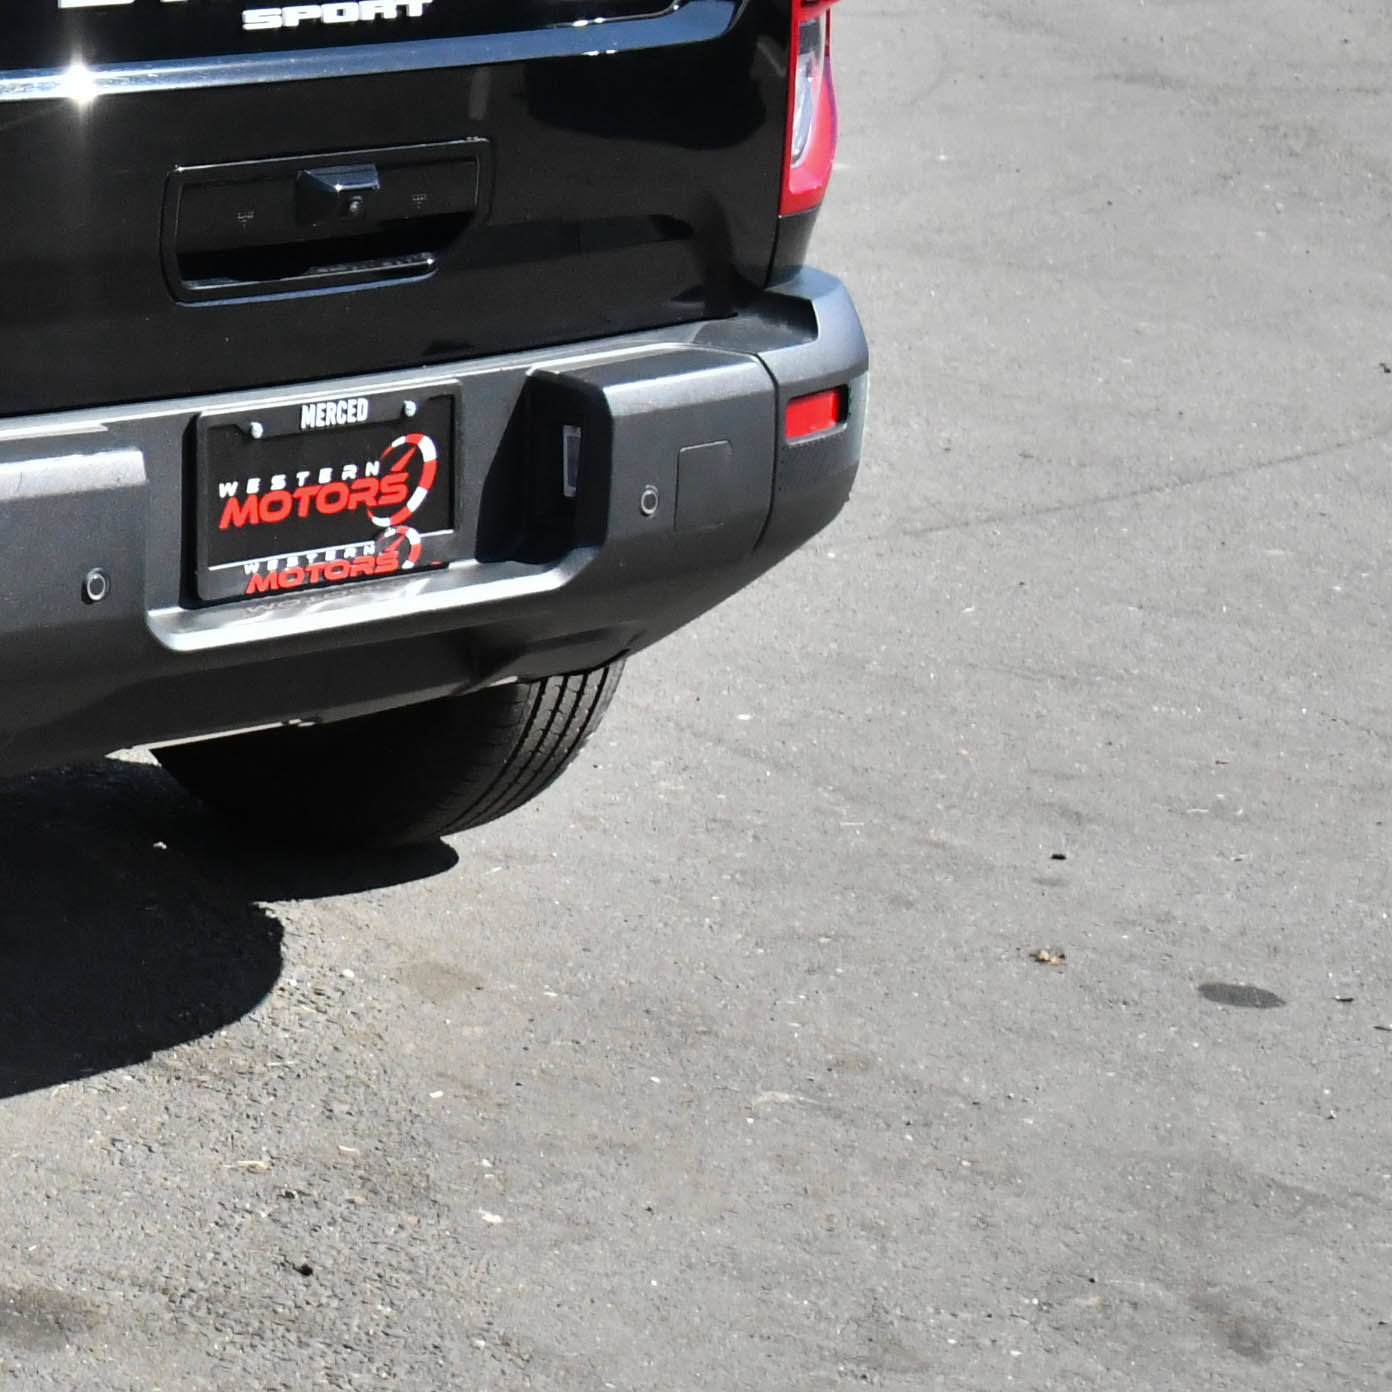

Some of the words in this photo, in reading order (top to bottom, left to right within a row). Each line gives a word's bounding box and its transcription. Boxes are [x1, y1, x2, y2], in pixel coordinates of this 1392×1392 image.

[301, 398, 369, 430] MERCED
[219, 461, 380, 498] WESTERN
[219, 472, 410, 529] MOTORS
[244, 544, 376, 575] WESTERN
[245, 550, 400, 594] MOTORS
